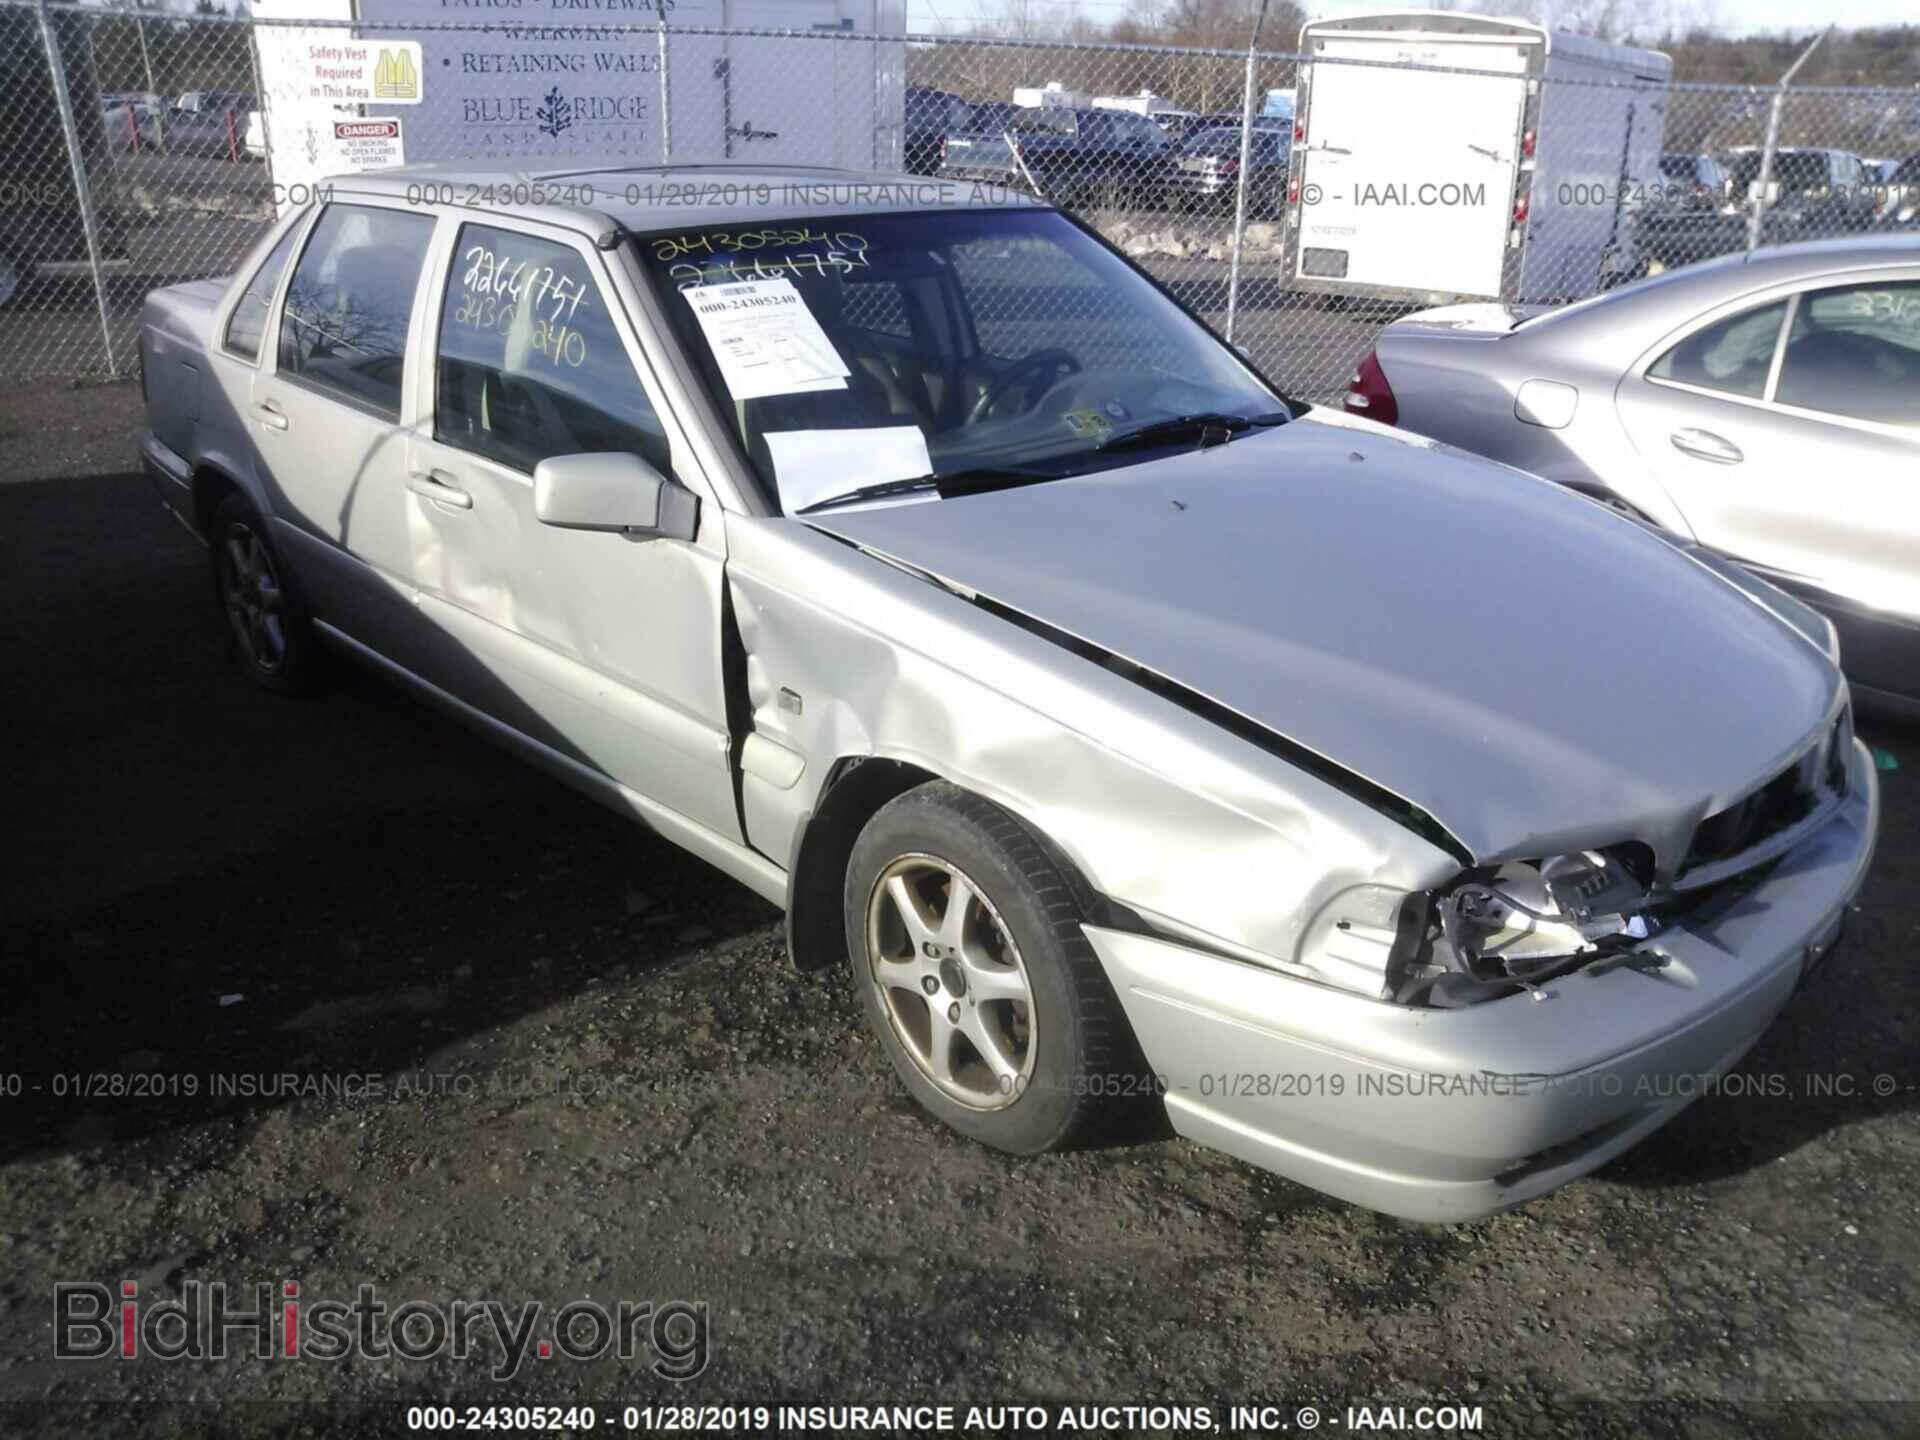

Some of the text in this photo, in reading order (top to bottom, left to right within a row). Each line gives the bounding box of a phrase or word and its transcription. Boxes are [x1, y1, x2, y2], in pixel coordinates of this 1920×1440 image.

[309, 46, 367, 63] Safety Vest
[462, 53, 662, 74] RETAINING WALLS
[315, 65, 363, 81] Required
[310, 84, 369, 98] in This Area
[463, 96, 649, 122] BLUE RIDGE
[343, 122, 390, 137] DANGER
[652, 228, 869, 261] 24305240
[699, 294, 798, 315] 000-24305240
